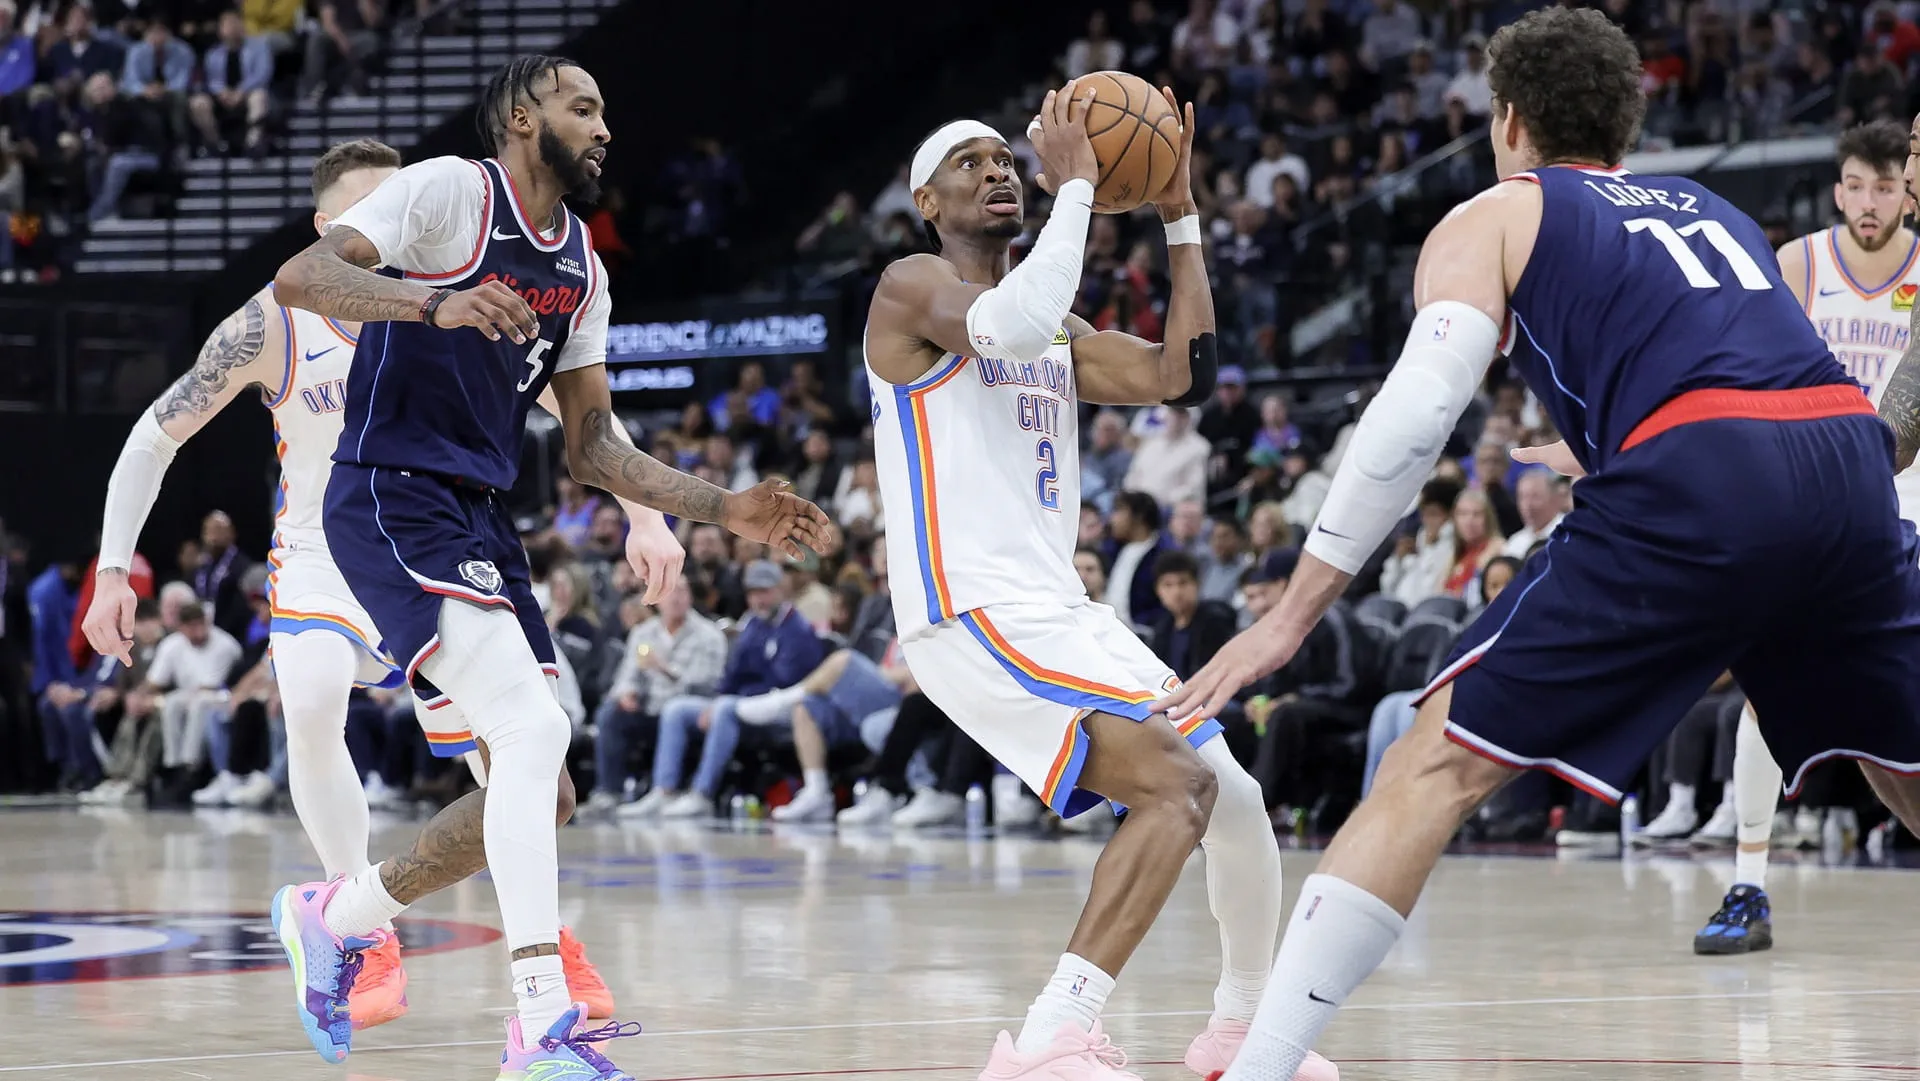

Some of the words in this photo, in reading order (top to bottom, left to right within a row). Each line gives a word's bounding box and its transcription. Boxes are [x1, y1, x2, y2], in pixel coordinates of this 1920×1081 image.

[1584, 180, 1699, 214] LOPEZ
[555, 261, 586, 279] RWANDA
[561, 256, 580, 269] VISIT
[1623, 218, 1773, 290] 11
[1818, 317, 1910, 351] KLAHOM
[516, 337, 554, 392] 5
[976, 356, 1073, 401] OKLAOM
[1837, 350, 1888, 381] CITY
[1017, 392, 1060, 437] CITY
[1036, 437, 1062, 513] 2
